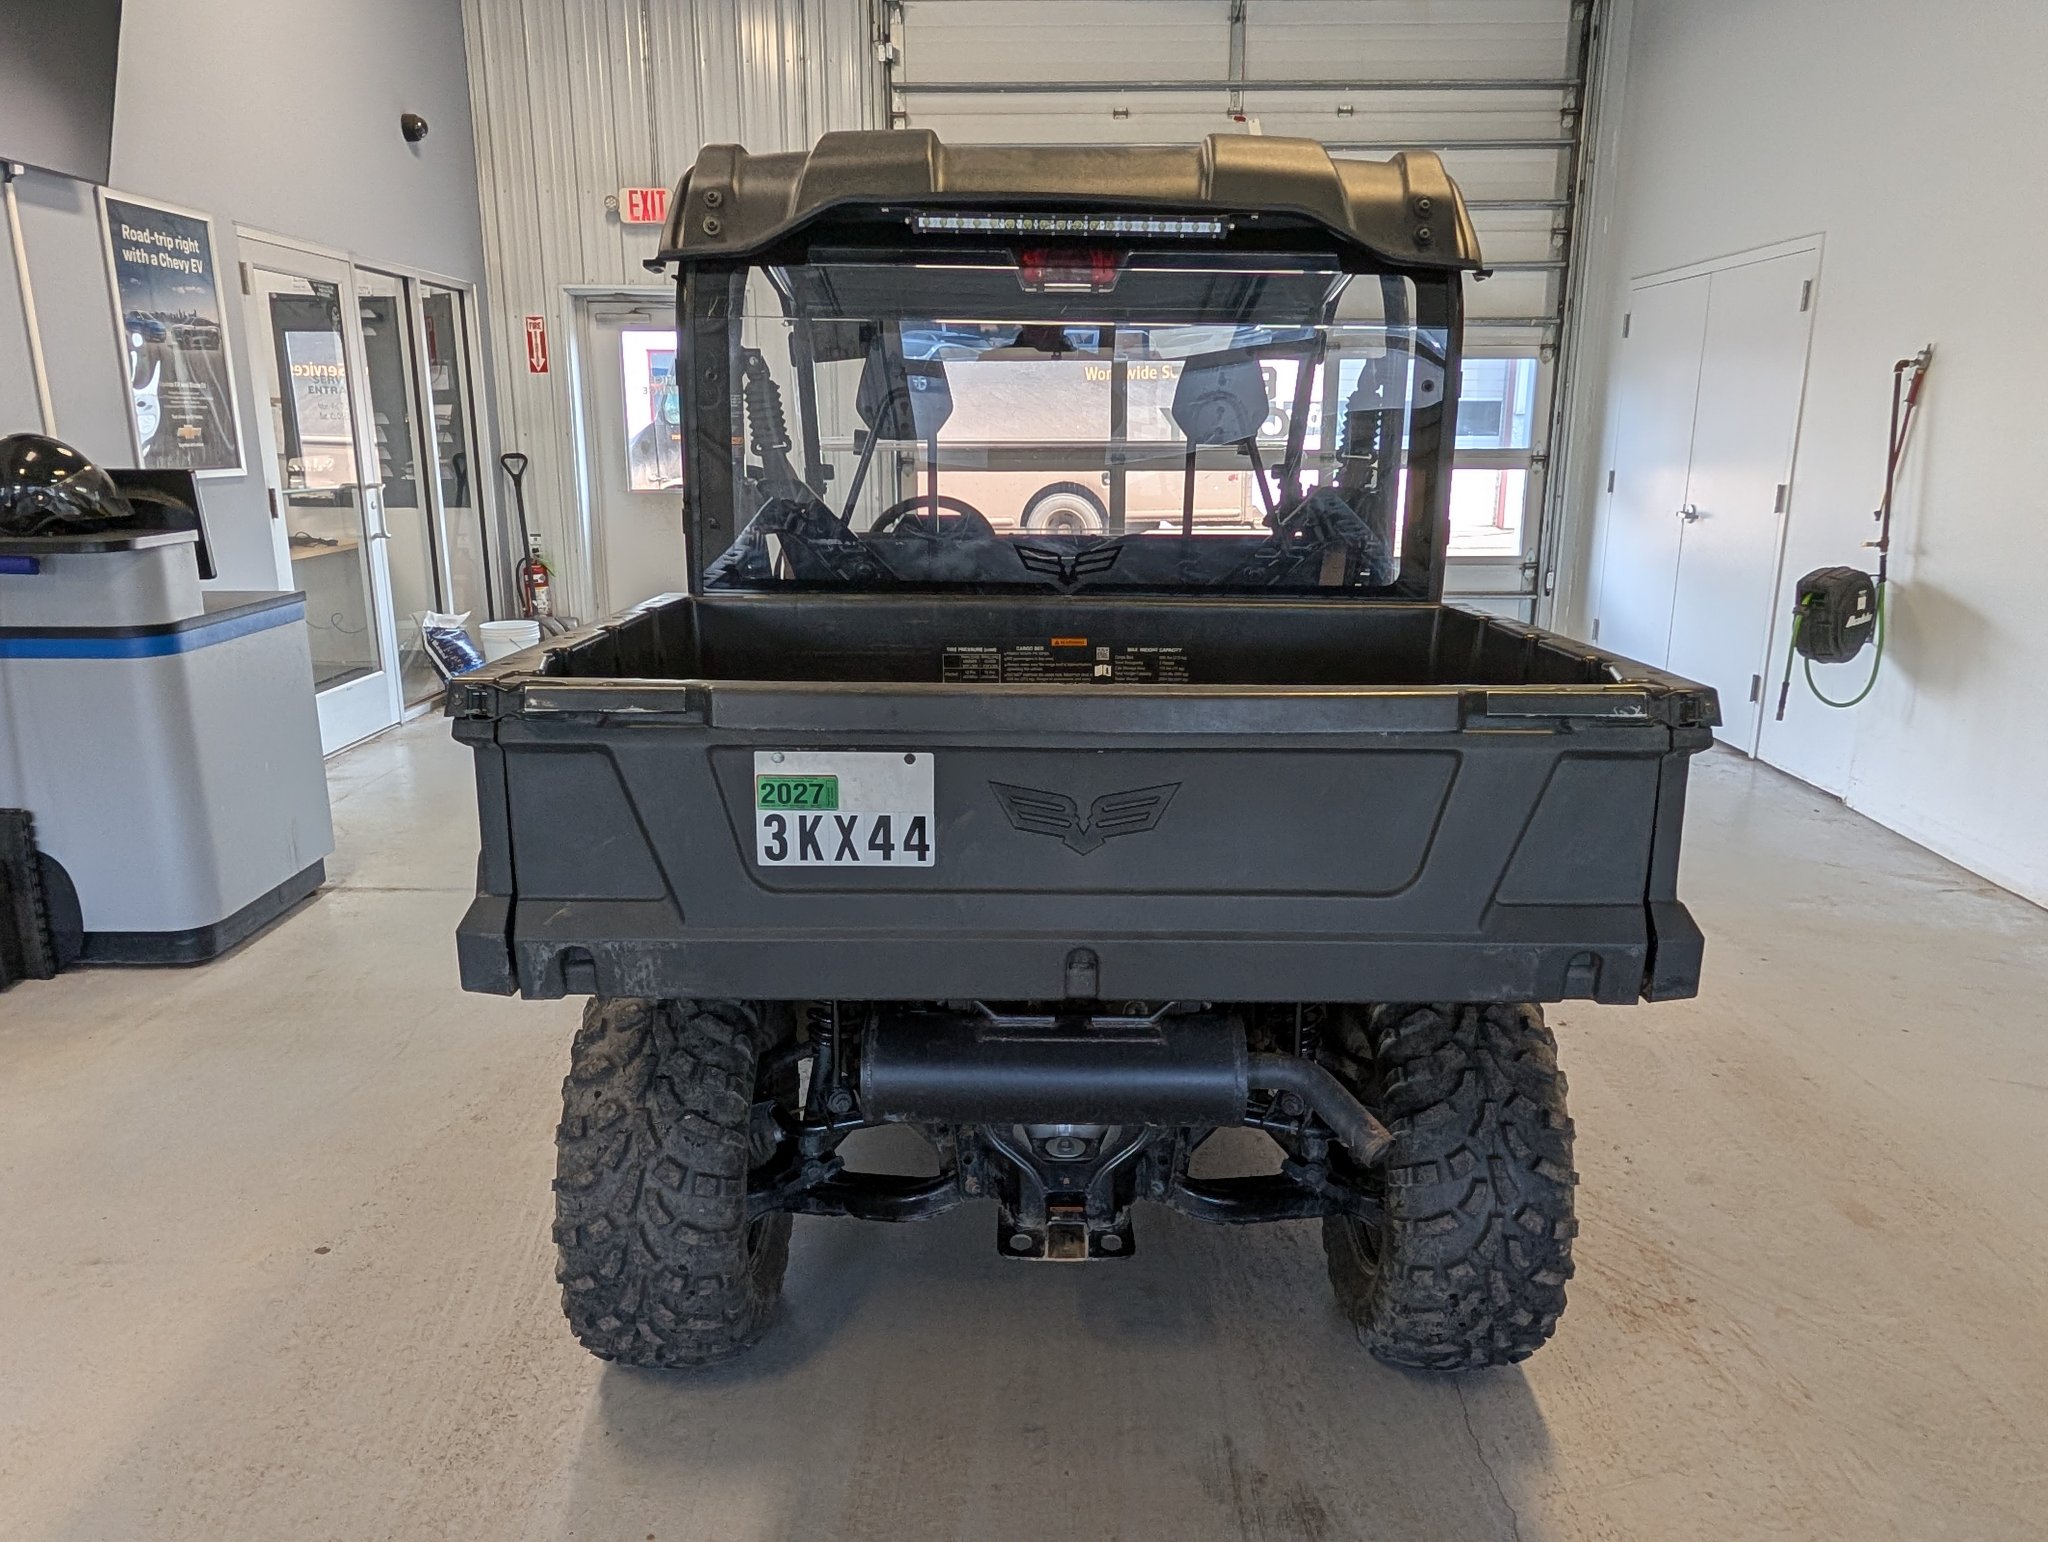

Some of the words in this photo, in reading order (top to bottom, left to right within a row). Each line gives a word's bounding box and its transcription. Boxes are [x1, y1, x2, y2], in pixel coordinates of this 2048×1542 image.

[628, 190, 666, 221] EXIT
[121, 224, 174, 250] Road-trip
[175, 236, 200, 255] right
[122, 247, 150, 264] with
[151, 253, 158, 266] a
[159, 252, 190, 274] Chevy
[191, 258, 203, 274] EV
[761, 783, 824, 804] 2027
[763, 813, 930, 862] 3KX44
